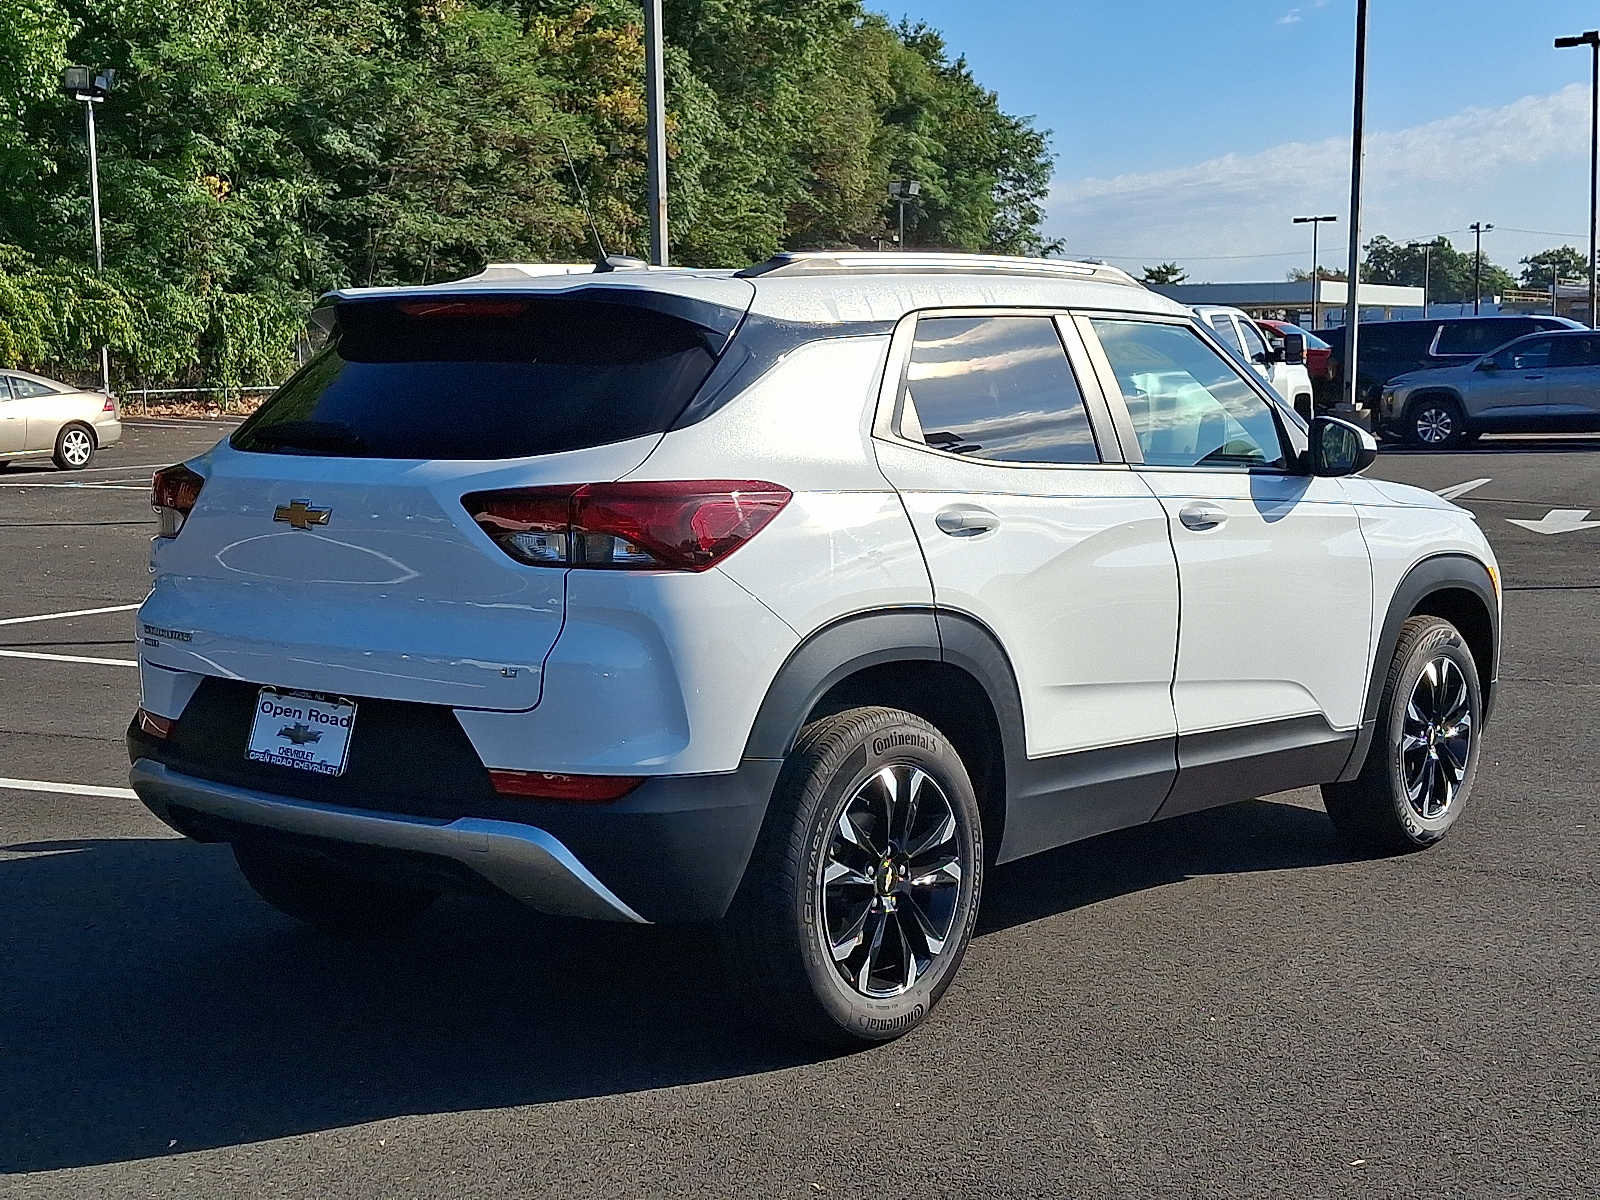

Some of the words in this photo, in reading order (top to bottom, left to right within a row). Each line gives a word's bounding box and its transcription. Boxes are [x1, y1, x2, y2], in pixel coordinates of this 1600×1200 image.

[261, 701, 302, 718] Open
[308, 709, 351, 727] Road
[278, 747, 316, 760] CHEVROLET
[872, 731, 930, 756] Continental
[250, 753, 270, 763] OPEN
[271, 755, 293, 767] ROAD
[864, 1003, 924, 1031] Continental
